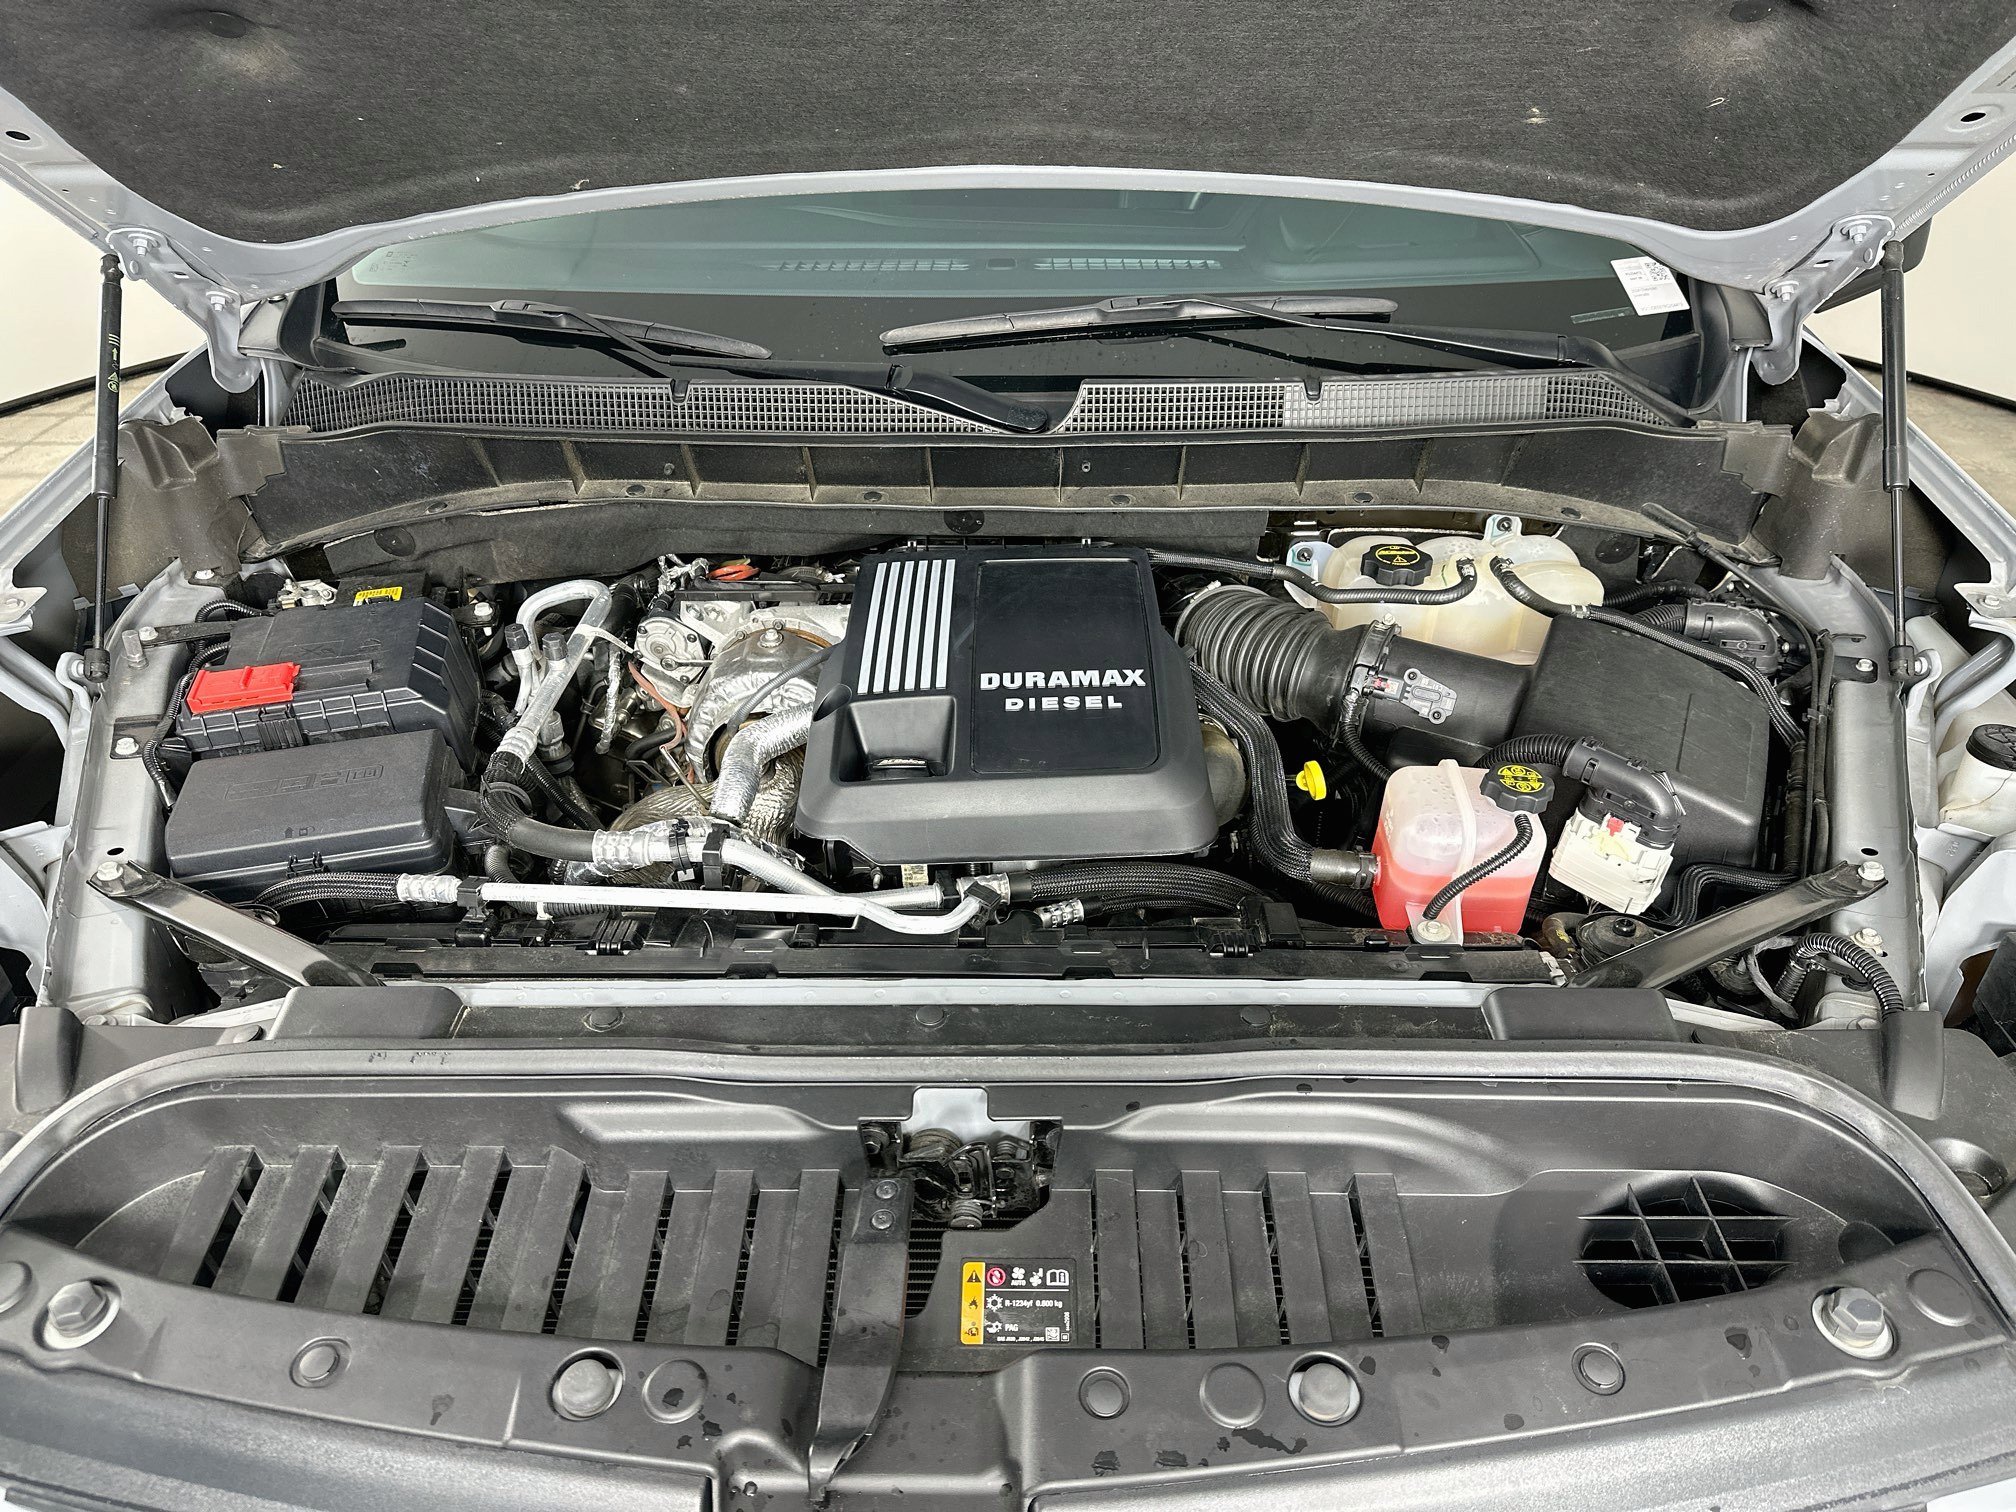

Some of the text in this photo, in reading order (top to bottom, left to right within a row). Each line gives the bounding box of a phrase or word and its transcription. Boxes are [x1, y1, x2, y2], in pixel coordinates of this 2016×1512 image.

[980, 669, 1146, 690] DURAMAX
[1005, 695, 1123, 711] DIESEL
[1054, 1299, 1063, 1309] kg
[1004, 1323, 1019, 1332] PAG
